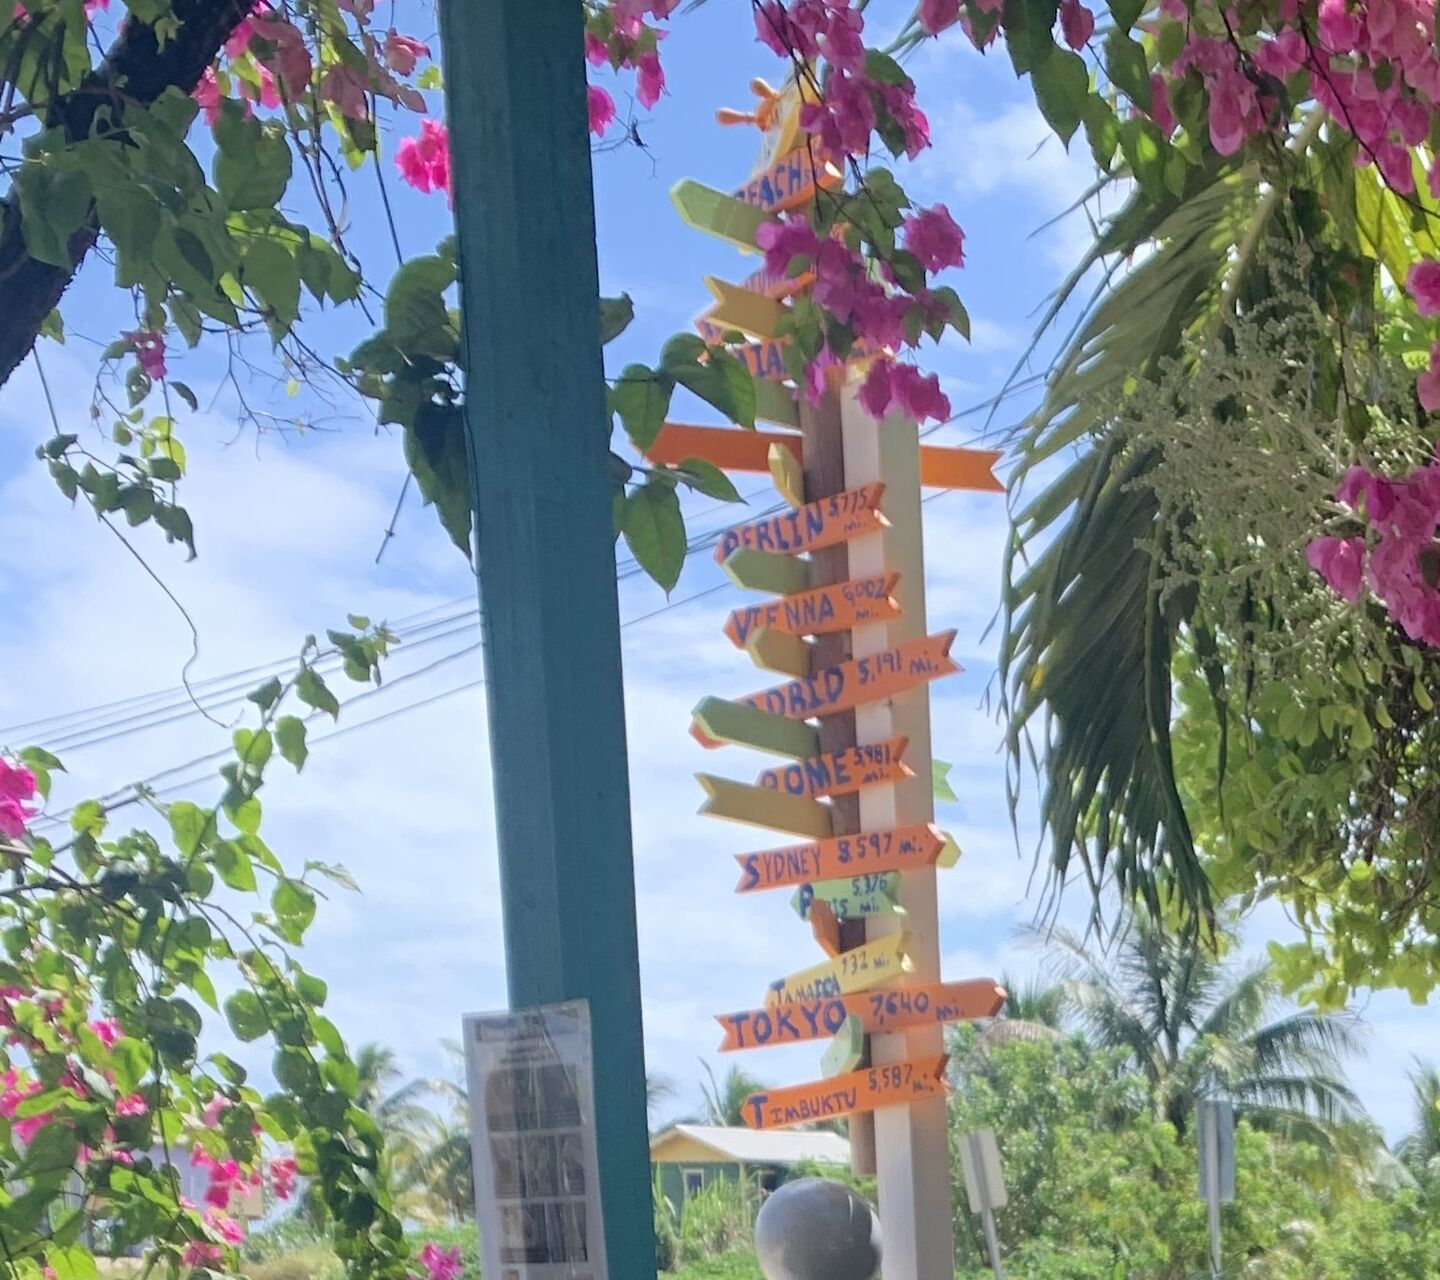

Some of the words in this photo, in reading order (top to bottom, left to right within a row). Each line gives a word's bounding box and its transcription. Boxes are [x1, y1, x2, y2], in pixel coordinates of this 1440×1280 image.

[743, 846, 821, 890] SYDNEY
[728, 1000, 847, 1048] TOKYO
[870, 992, 929, 1026] 7,640
[747, 1088, 857, 1129] TIMBUKTU
